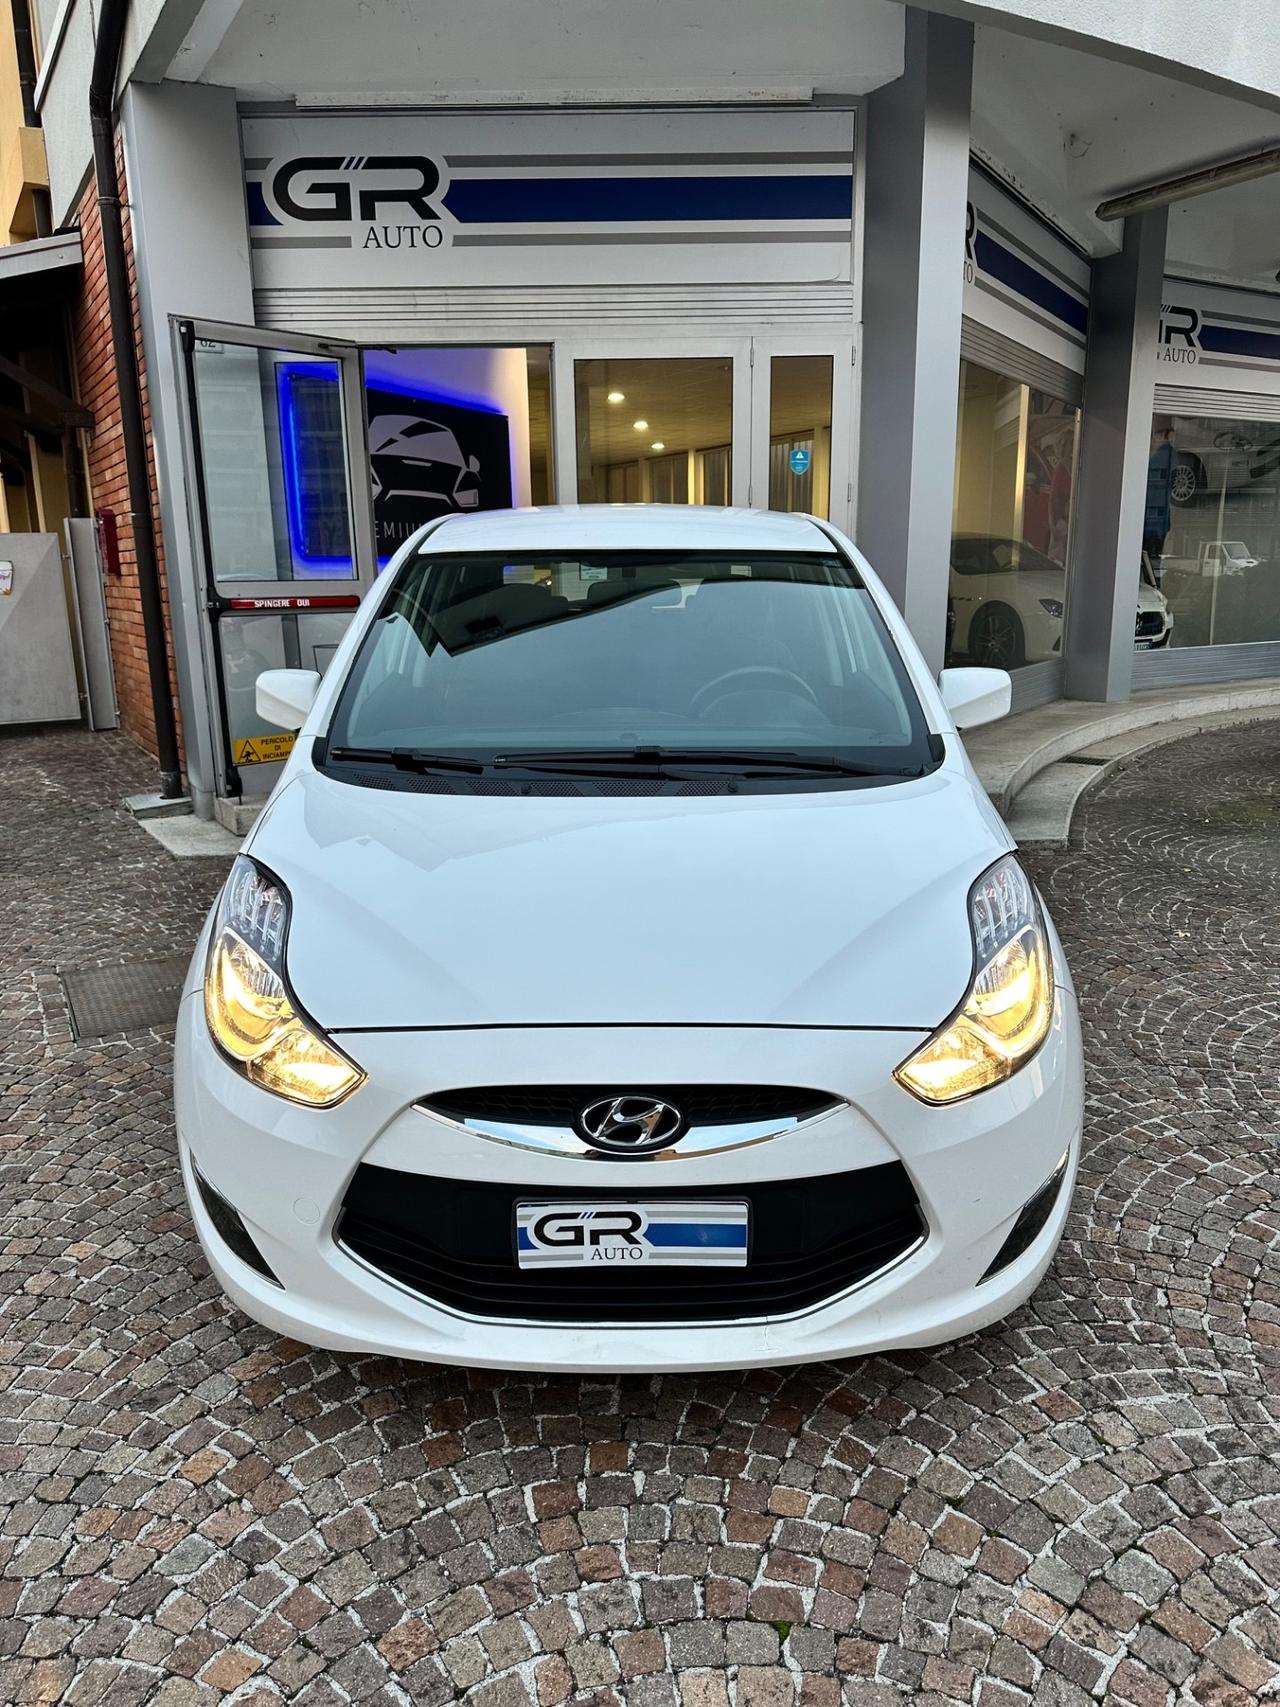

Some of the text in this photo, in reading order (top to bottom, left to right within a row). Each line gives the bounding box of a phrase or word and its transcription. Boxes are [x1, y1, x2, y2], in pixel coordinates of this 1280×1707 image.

[273, 155, 442, 222] GR
[363, 225, 443, 249] AUTO
[965, 200, 975, 261] R
[1158, 303, 1199, 347] R
[1163, 347, 1197, 364] AUTO
[374, 520, 422, 538] EMIU
[254, 600, 291, 608] SPINGERE
[260, 736, 294, 745] PERICOLO
[262, 750, 291, 760] INCIAMP
[533, 1211, 642, 1247] GR
[591, 1247, 643, 1260] AUTO
